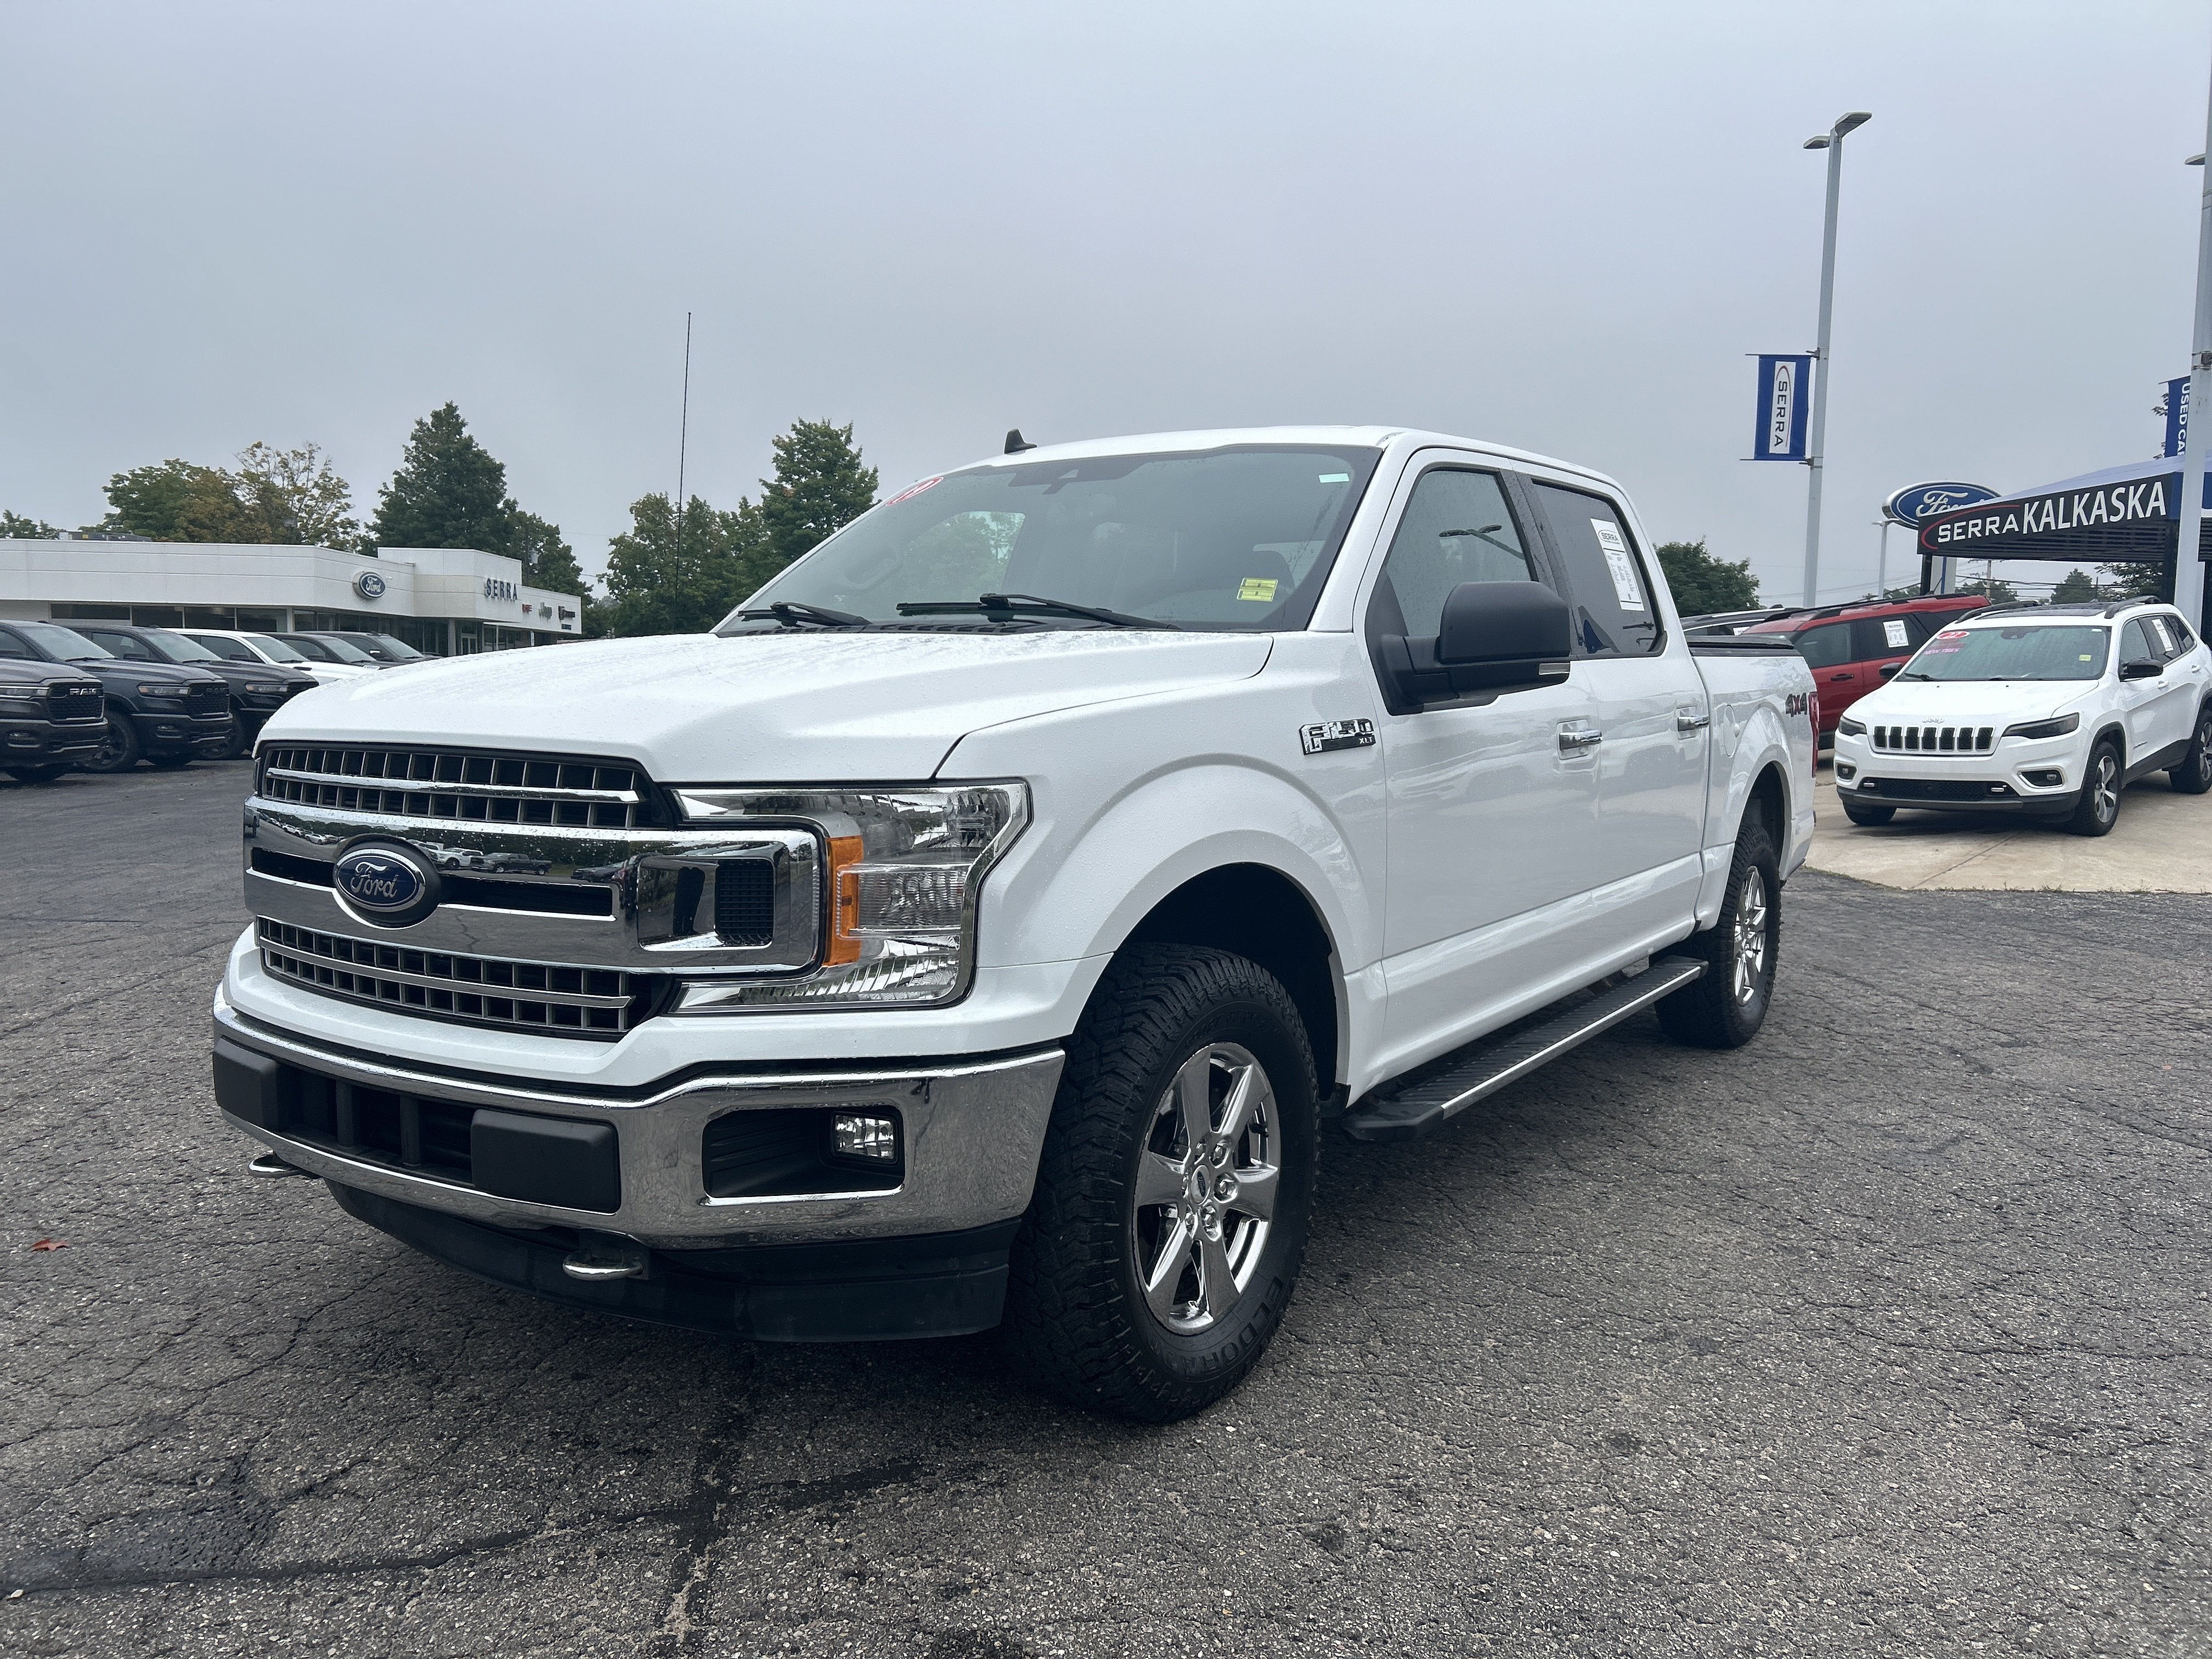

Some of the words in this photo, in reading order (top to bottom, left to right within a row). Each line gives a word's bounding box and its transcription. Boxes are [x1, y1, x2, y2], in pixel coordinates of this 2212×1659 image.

[1774, 380, 1787, 447] SERRA
[2179, 382, 2191, 425] USED
[1937, 513, 2019, 543] SERRA
[2023, 481, 2166, 535] KALKASKA
[1601, 532, 1619, 541] SERRA
[365, 576, 381, 592] Ford
[486, 578, 518, 600] SERRA
[1358, 736, 1373, 745] XLT
[349, 861, 399, 898] Ford
